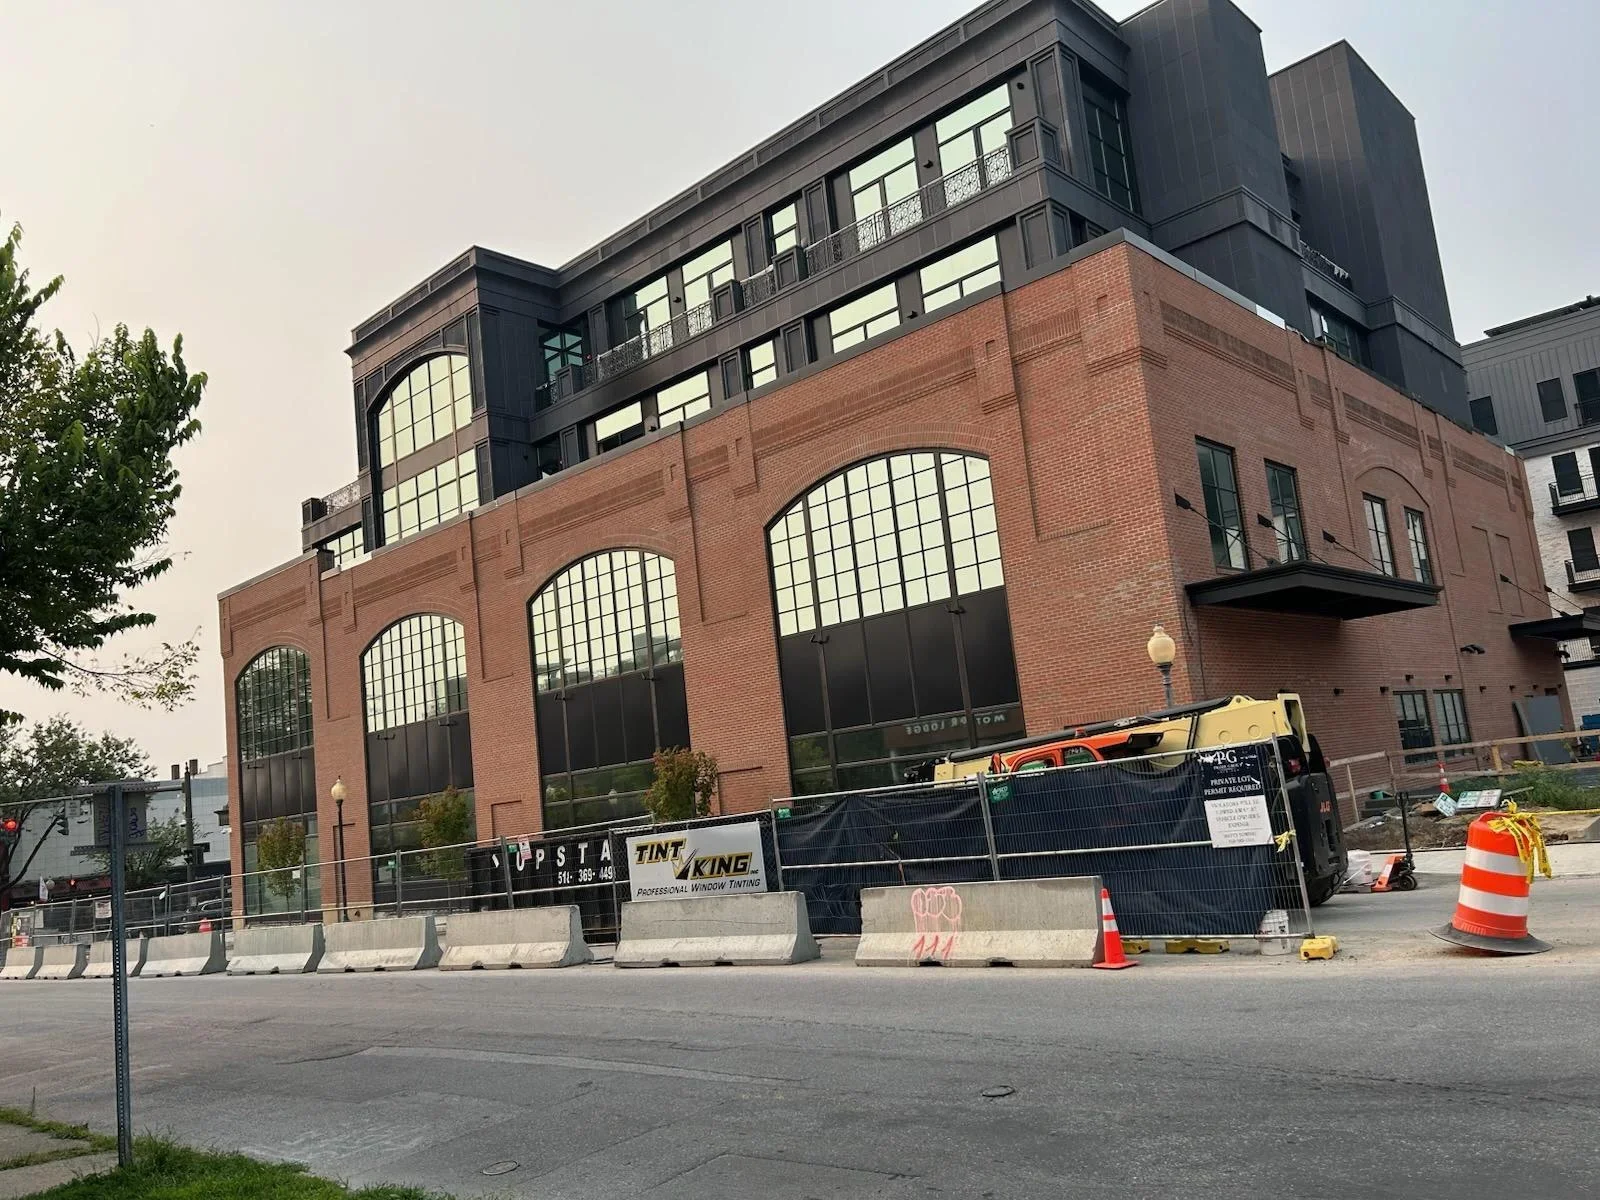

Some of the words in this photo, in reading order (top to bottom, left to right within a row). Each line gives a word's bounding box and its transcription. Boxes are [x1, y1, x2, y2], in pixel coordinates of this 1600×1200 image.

[1211, 777, 1237, 786] PRIVATE
[1237, 775, 1251, 783] LOT
[1228, 783, 1261, 793] REQUIRED
[635, 838, 687, 864] TINT
[690, 852, 753, 880] KING
[636, 886, 688, 897] PROFESSIONAL
[691, 880, 727, 892] WINDOW
[729, 878, 761, 889] TINTING
